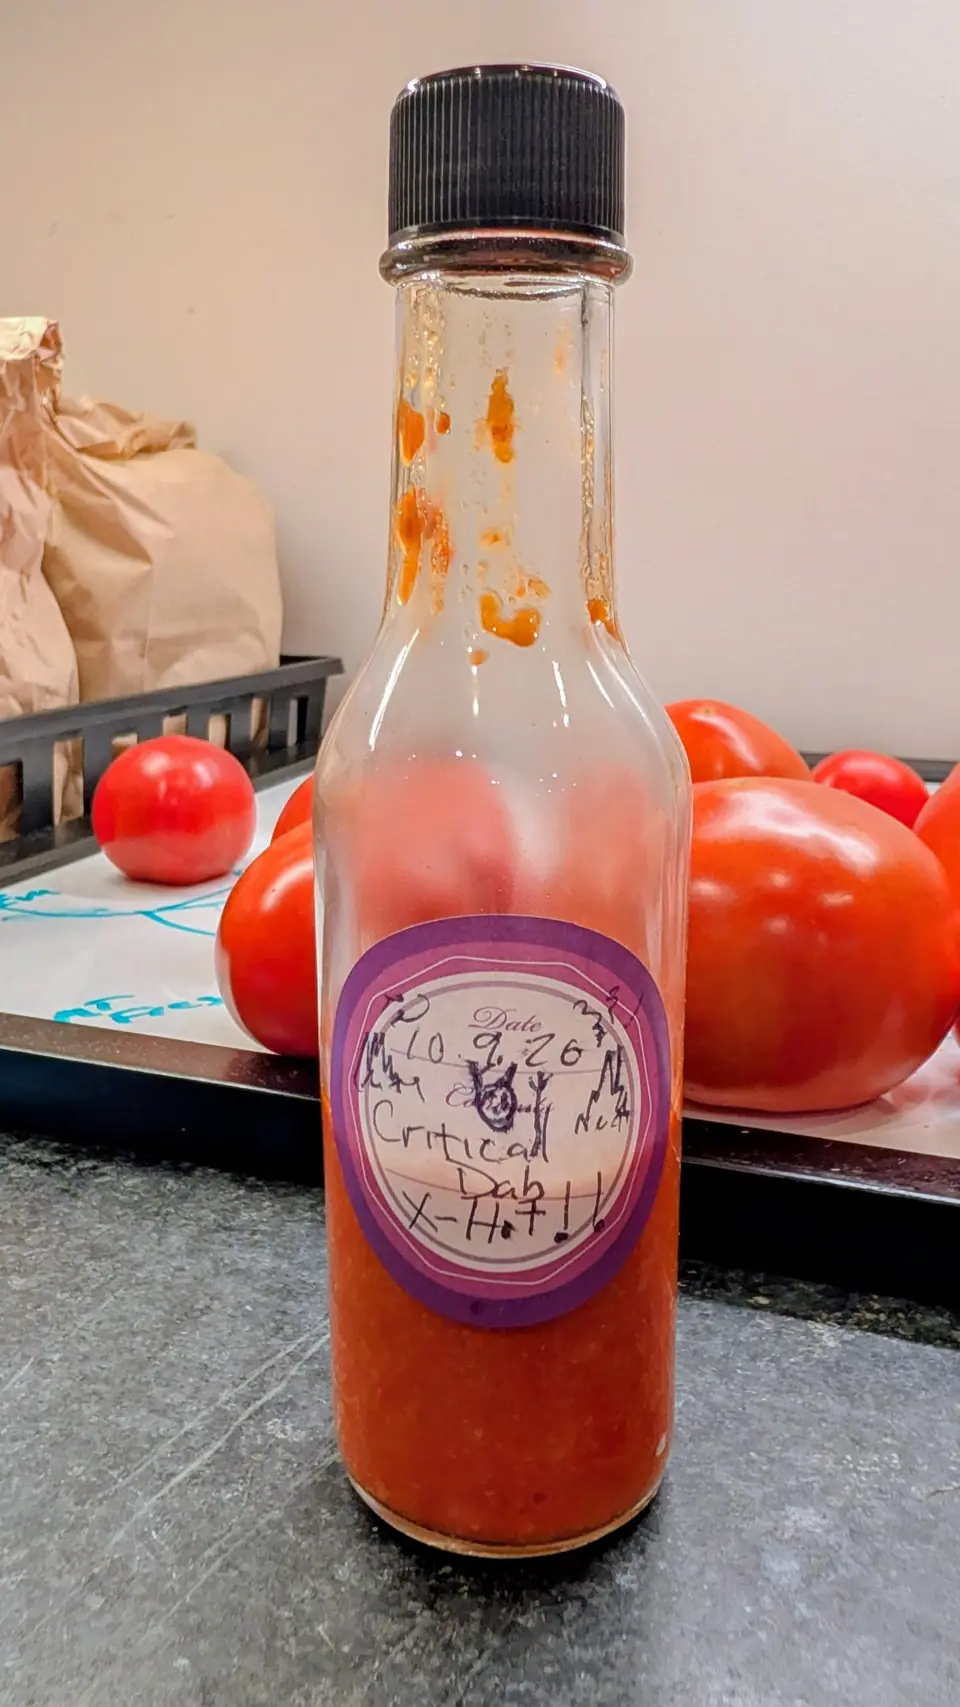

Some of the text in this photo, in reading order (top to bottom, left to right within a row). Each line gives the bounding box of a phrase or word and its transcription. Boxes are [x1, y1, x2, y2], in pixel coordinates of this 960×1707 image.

[468, 1006, 543, 1032] Date
[373, 1099, 549, 1163] Critical
[458, 1160, 545, 1200] Dab
